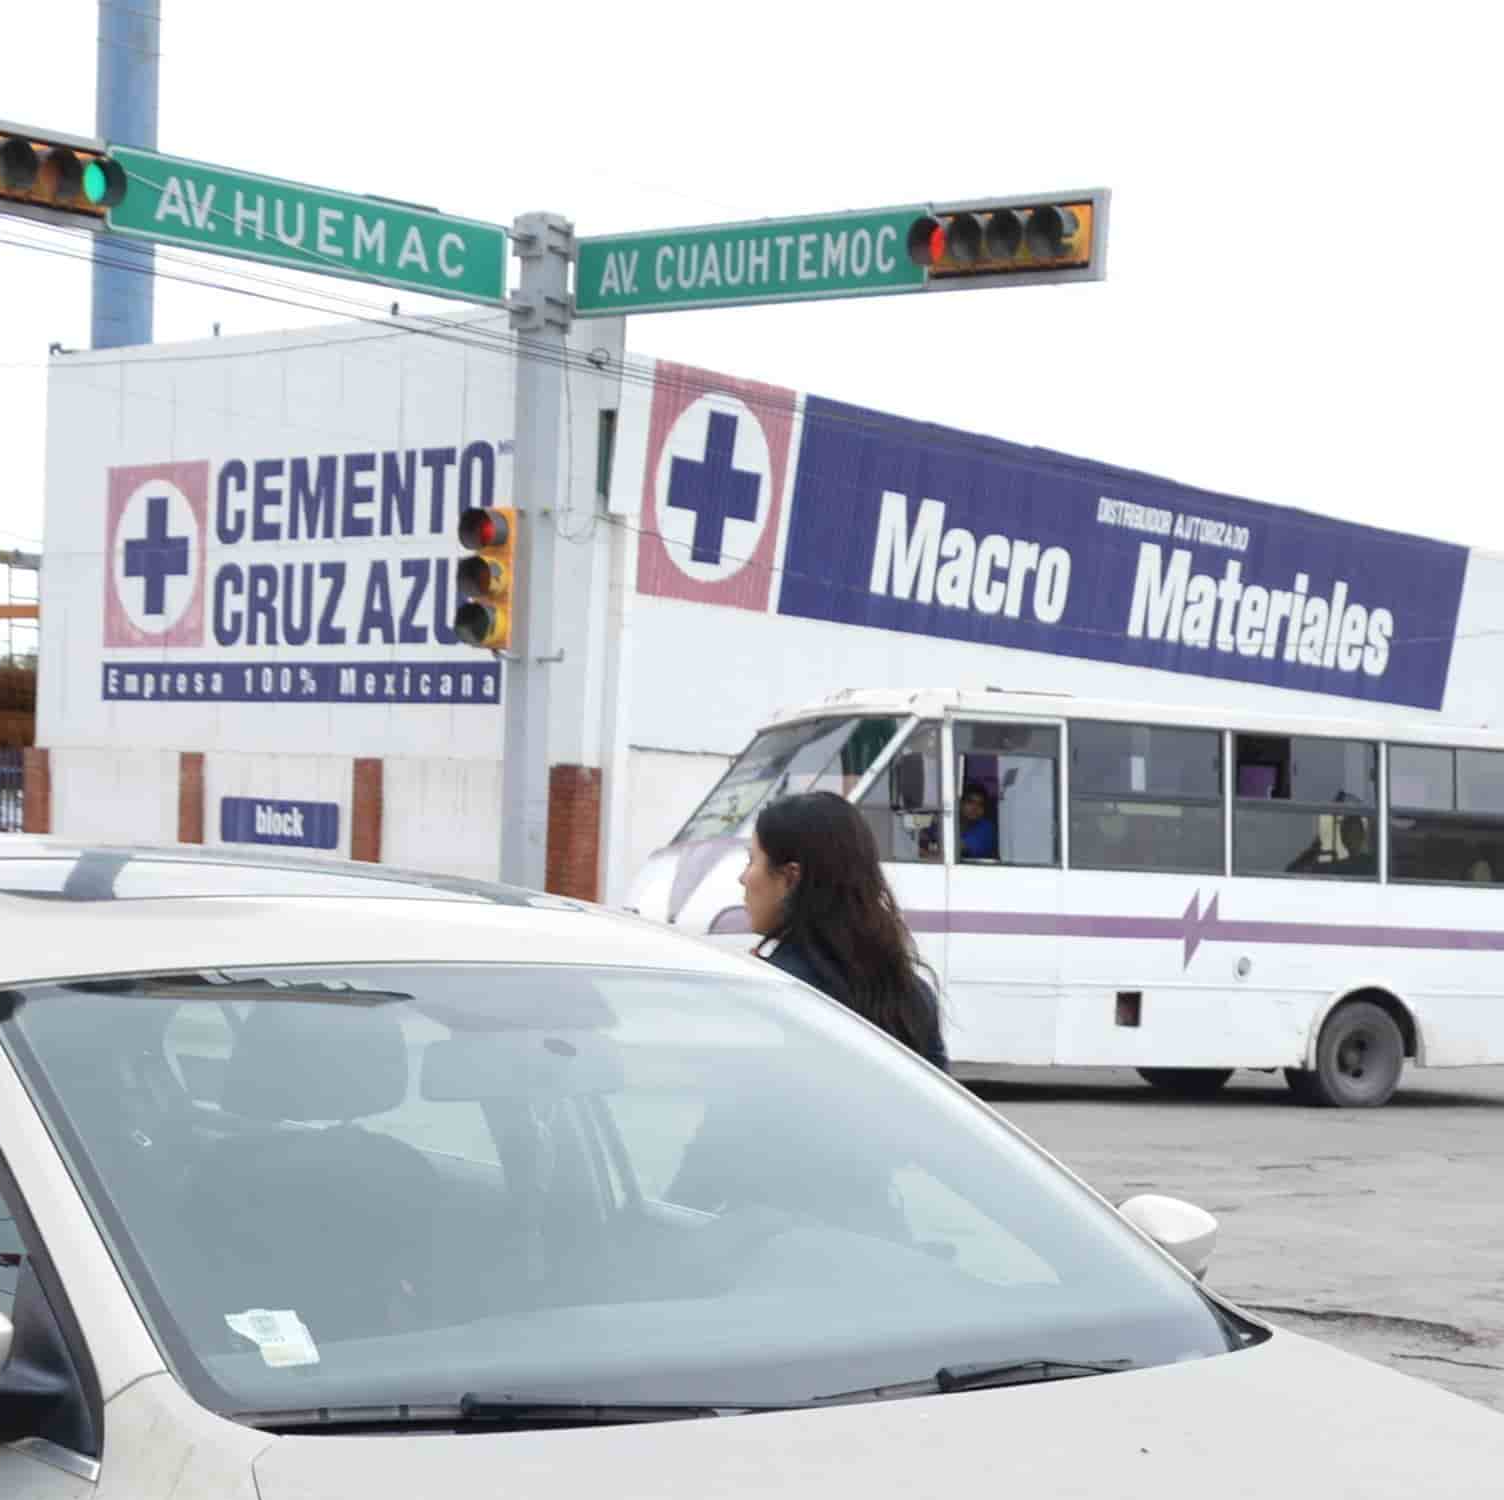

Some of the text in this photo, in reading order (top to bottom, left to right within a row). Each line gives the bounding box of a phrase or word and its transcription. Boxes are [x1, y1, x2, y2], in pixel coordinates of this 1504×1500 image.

[154, 175, 466, 278] AV. HUEMAC
[599, 225, 897, 297] AV. CUAUHTEMOC
[215, 440, 495, 545] CEMENTO
[212, 557, 461, 647] CRUZ AZU
[870, 489, 1072, 625] Macro
[1127, 540, 1394, 677] Materiales
[107, 667, 496, 699] Empresa 100% Mexicana
[255, 804, 304, 838] block
